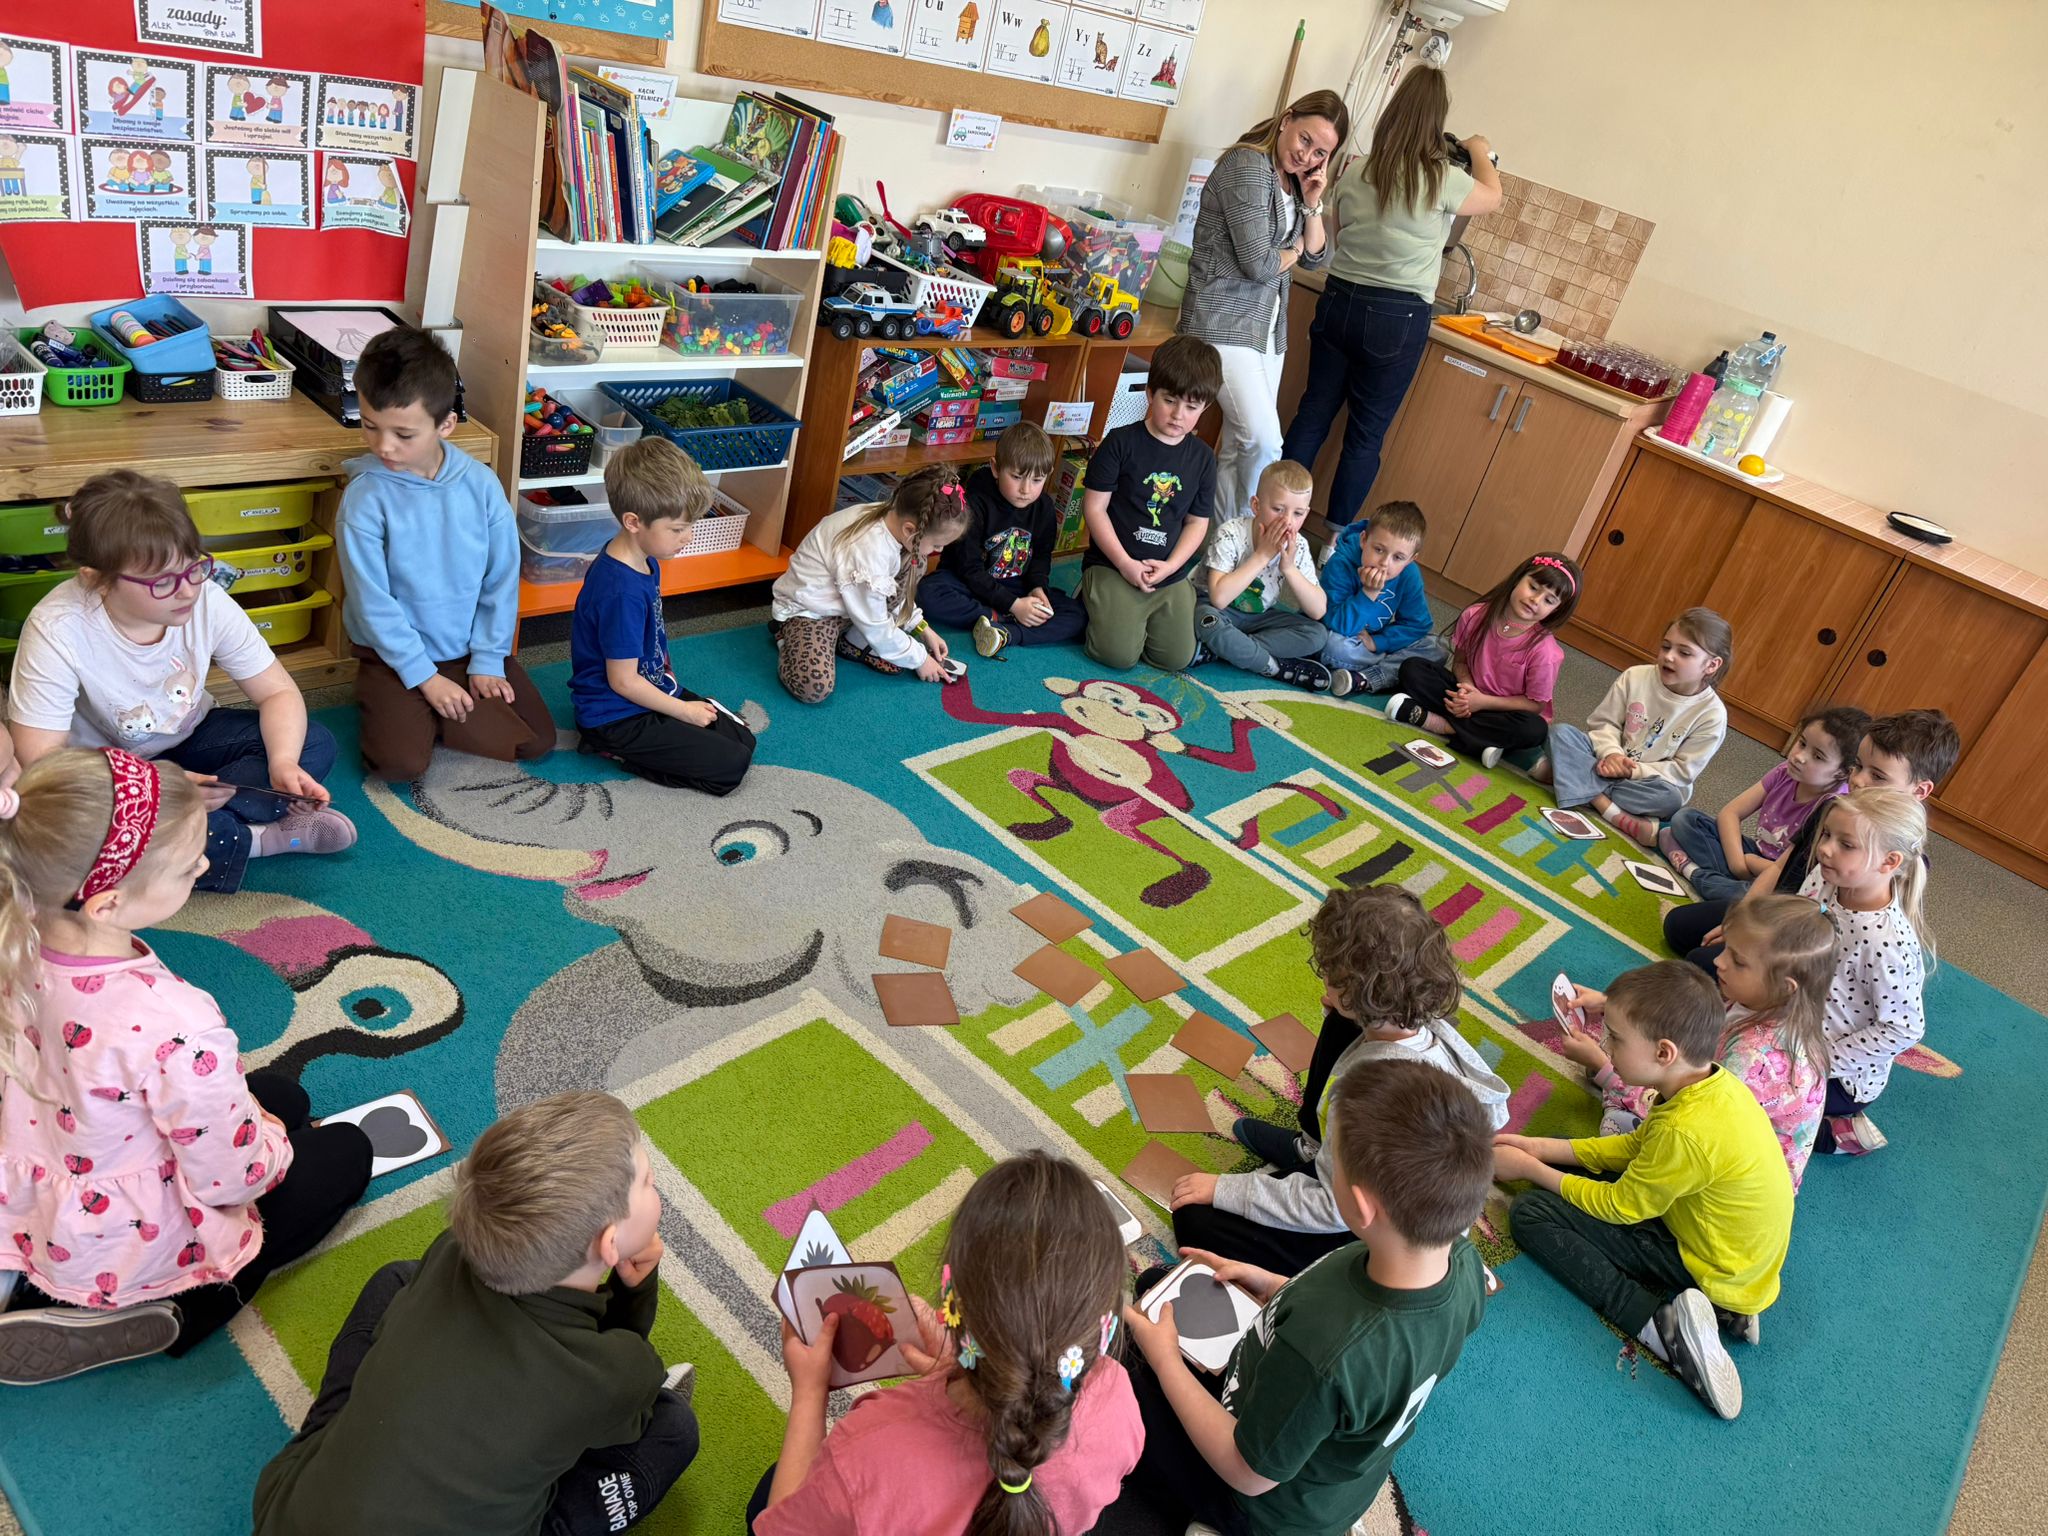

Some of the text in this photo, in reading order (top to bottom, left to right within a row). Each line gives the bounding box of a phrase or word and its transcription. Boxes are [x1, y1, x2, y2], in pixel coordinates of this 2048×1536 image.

[151, 21, 172, 30] ALEK
[166, 8, 227, 30] zasady:
[598, 1473, 627, 1531] BANAOE
[628, 1500, 638, 1519] POP
